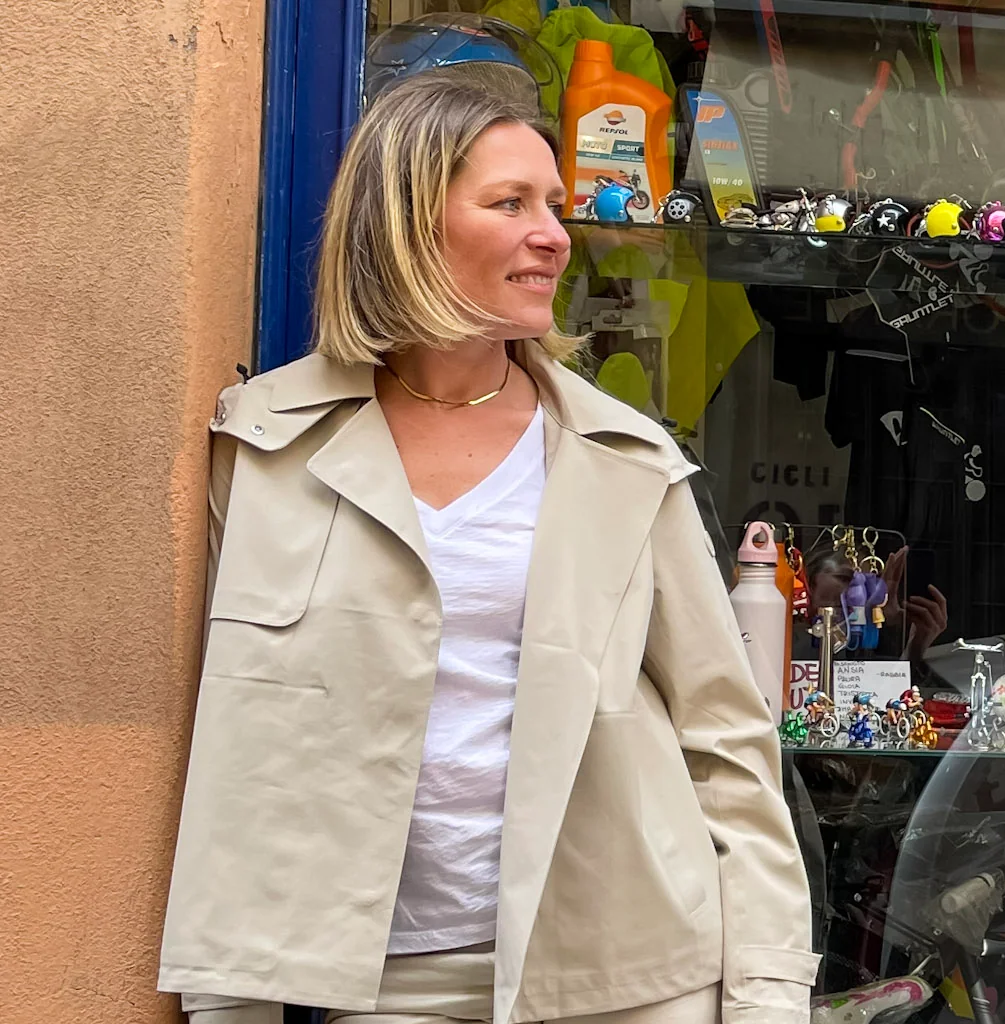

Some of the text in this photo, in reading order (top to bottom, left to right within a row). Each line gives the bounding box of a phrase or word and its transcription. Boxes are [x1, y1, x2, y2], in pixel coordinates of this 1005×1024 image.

[599, 127, 628, 135] REPSOL
[581, 140, 641, 152] MOTO SPORT
[889, 293, 954, 329] GAUNTLET
[750, 462, 830, 487] CICLI
[838, 666, 864, 674] ANSIA
